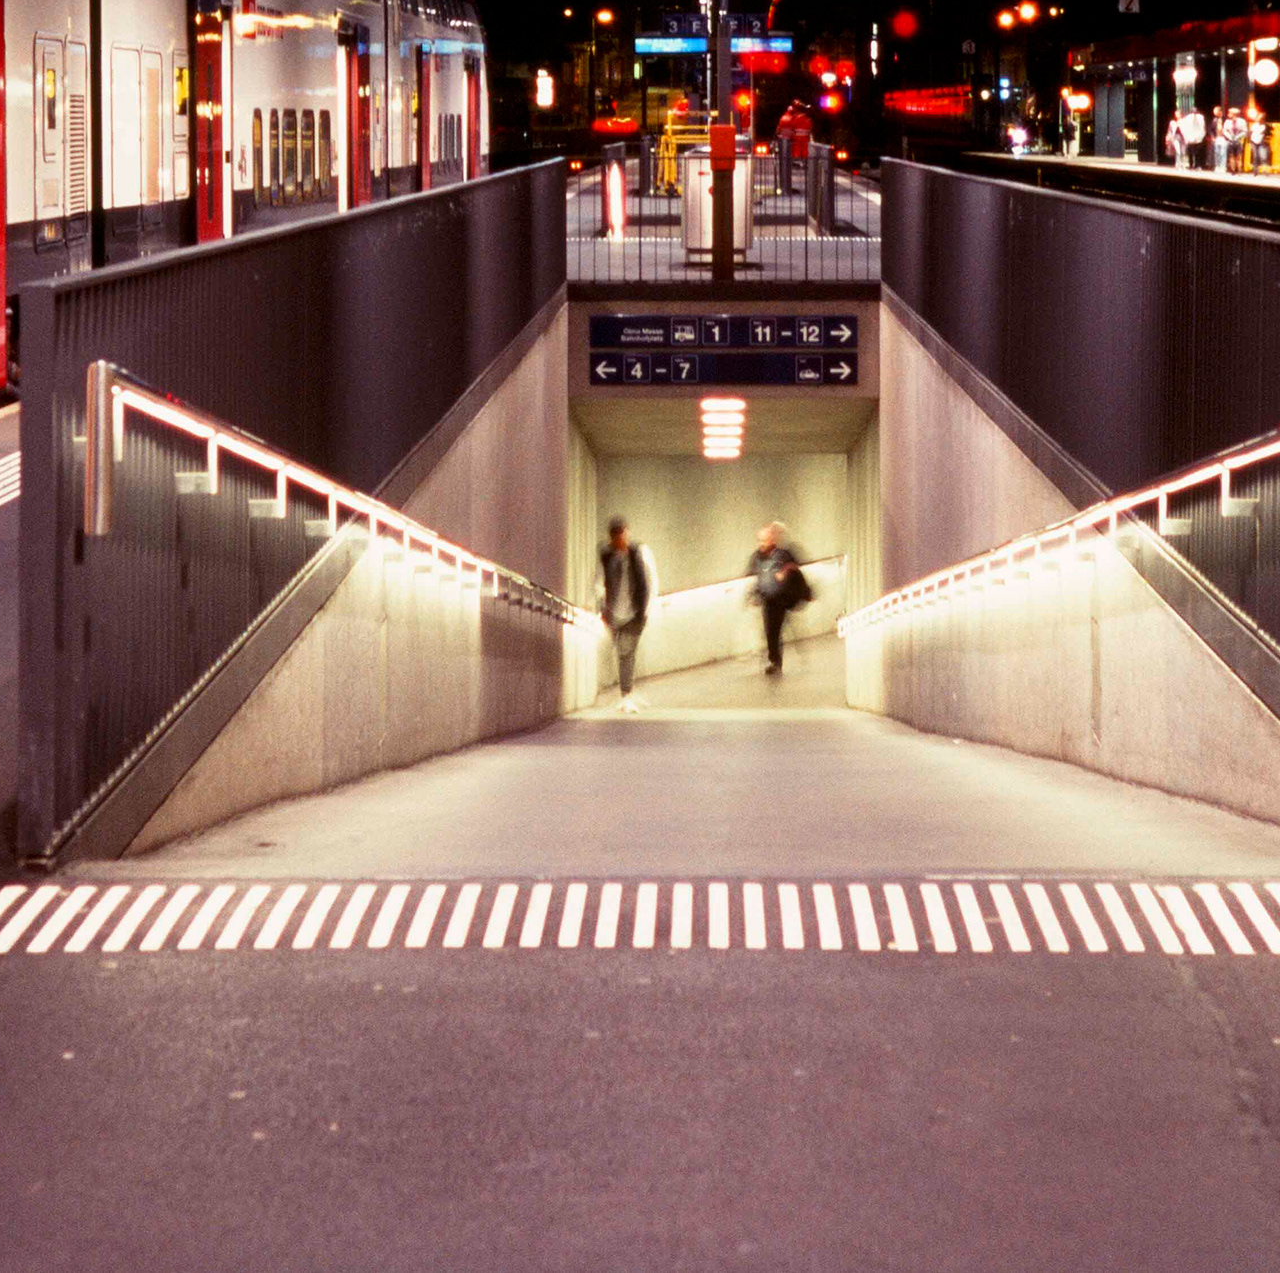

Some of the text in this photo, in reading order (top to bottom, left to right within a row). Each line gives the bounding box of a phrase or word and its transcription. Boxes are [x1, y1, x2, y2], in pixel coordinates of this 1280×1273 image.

[711, 326, 720, 341] 1
[754, 326, 771, 341] 11
[799, 326, 820, 342] 12
[631, 363, 642, 378] 4
[679, 363, 691, 378] 7
